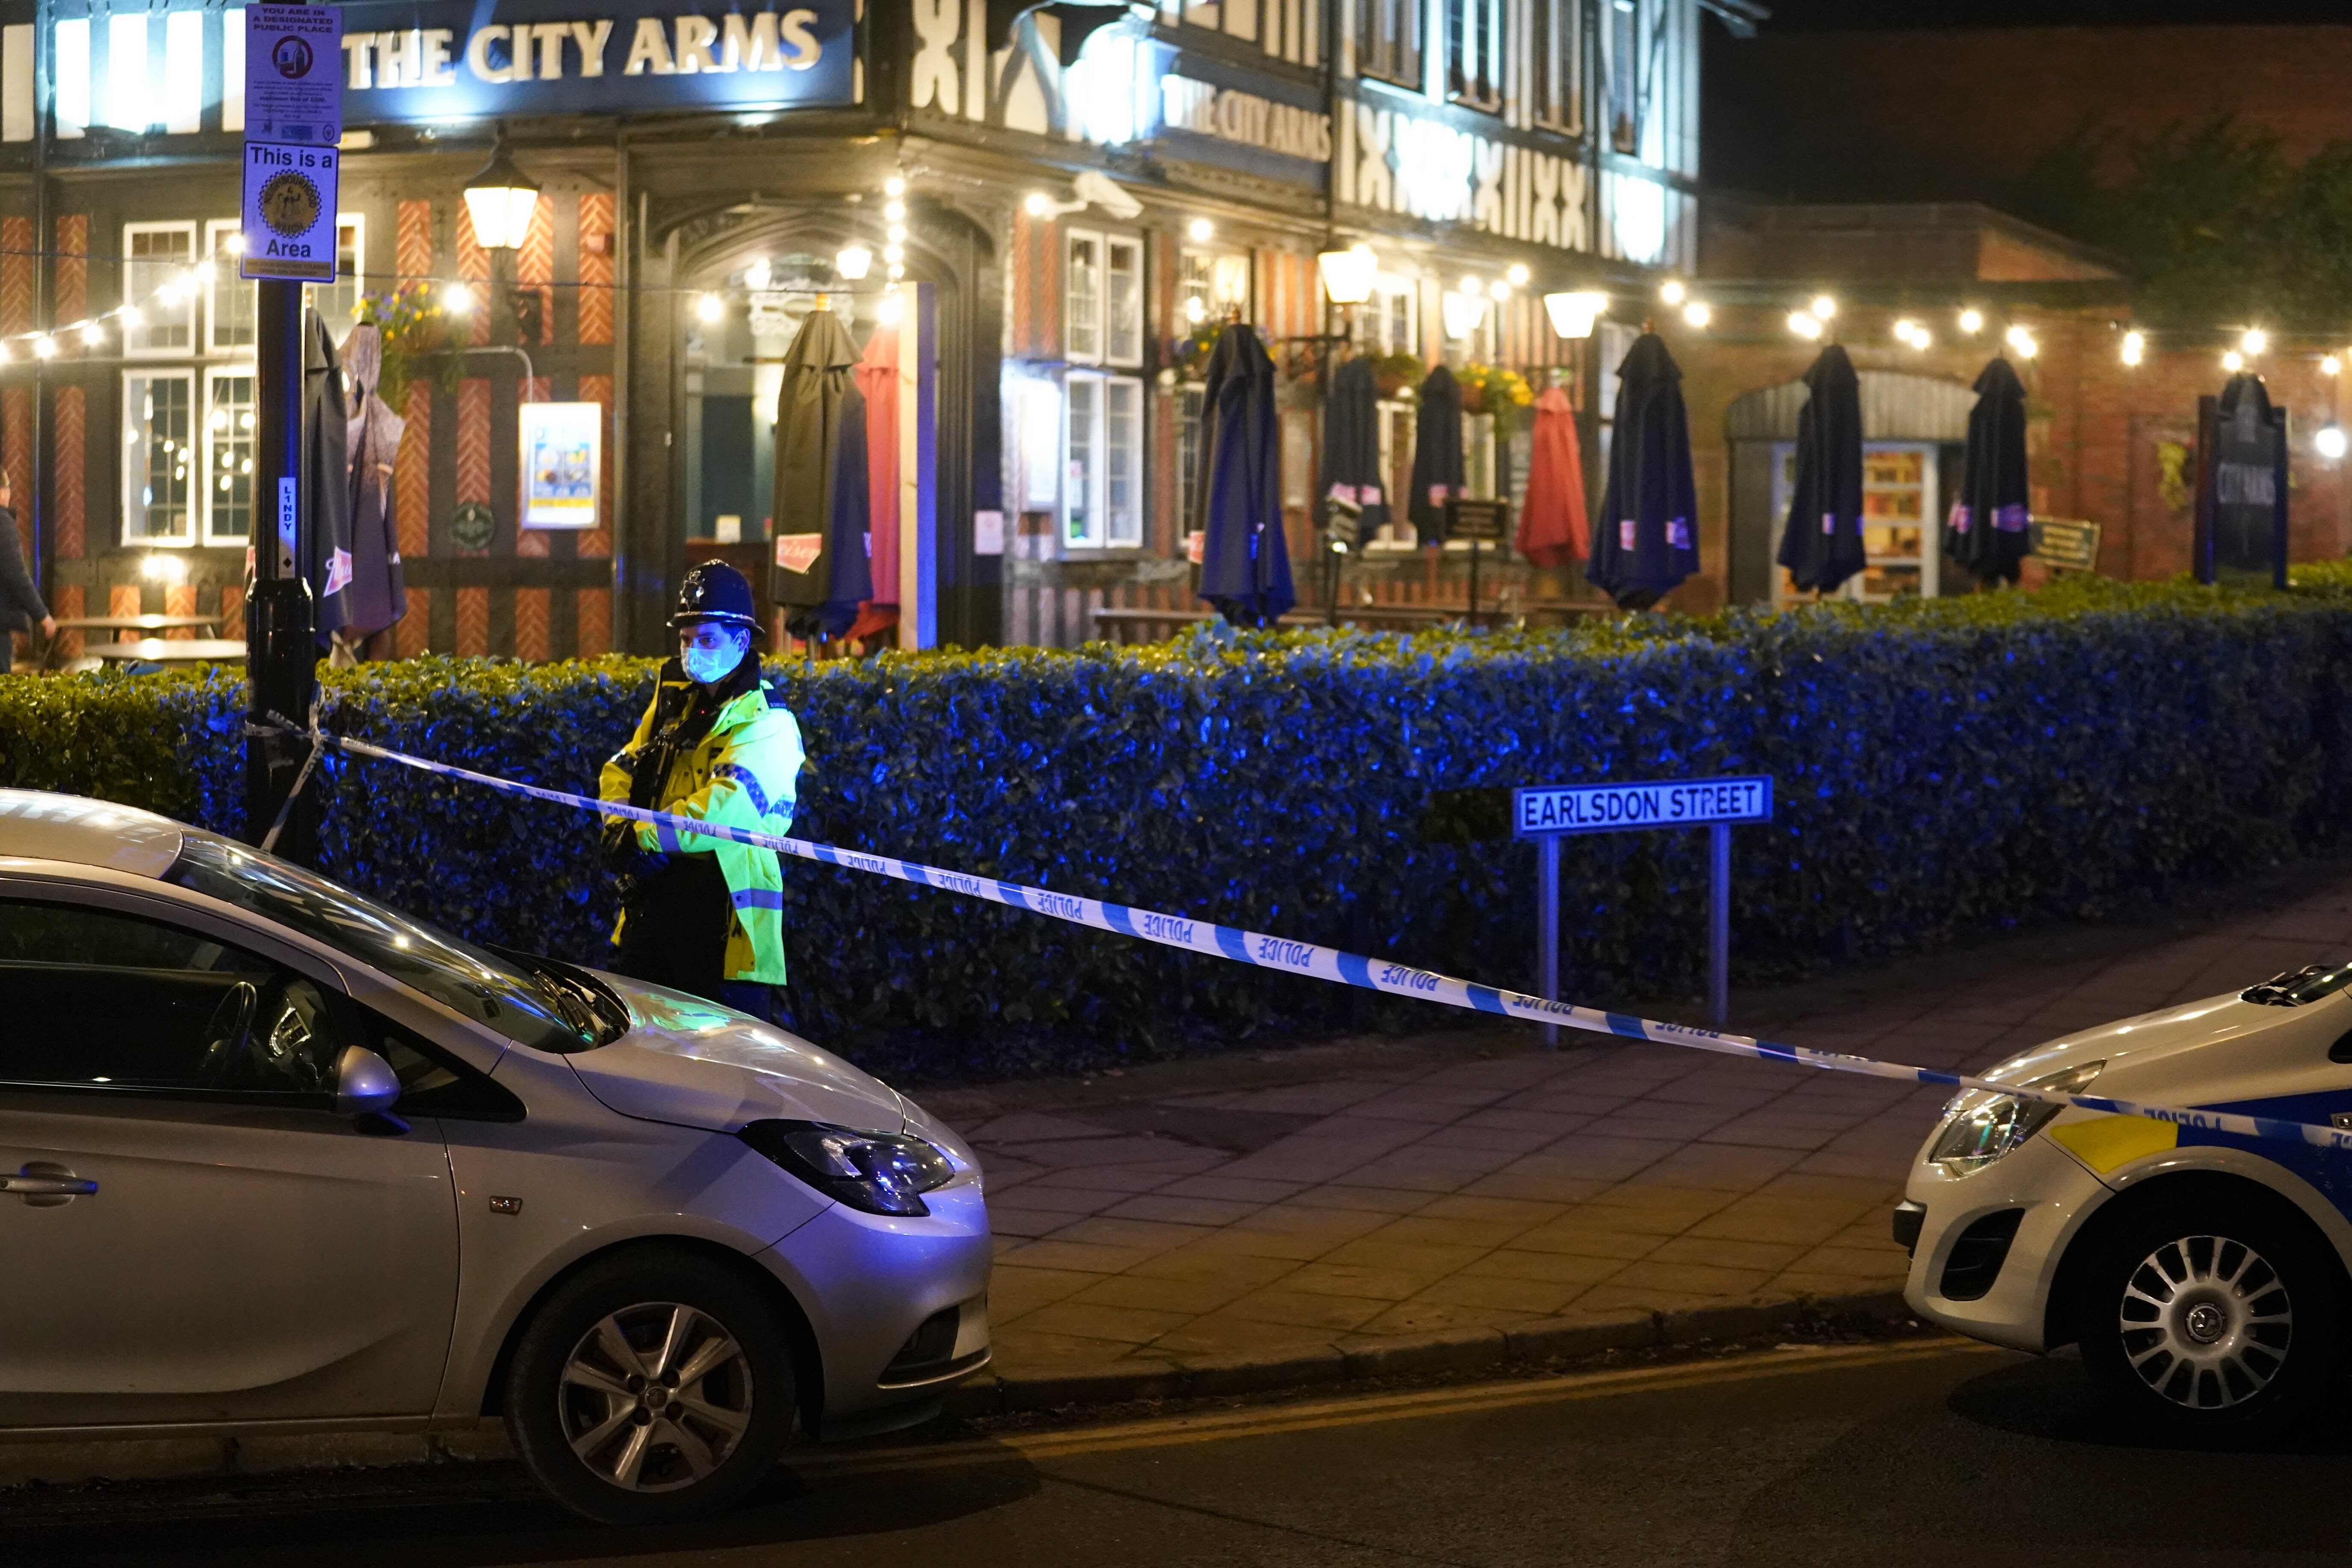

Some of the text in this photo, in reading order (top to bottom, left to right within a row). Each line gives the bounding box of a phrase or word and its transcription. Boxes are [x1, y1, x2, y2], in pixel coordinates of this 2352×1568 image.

[264, 16, 333, 24] DESIGNATED
[341, 9, 823, 89] THE CITY ARMS
[1218, 89, 1271, 146] CITY
[1269, 102, 1331, 163] ARMS
[251, 147, 332, 168] This is a
[266, 239, 311, 258] Area
[1525, 785, 1757, 826] EARLSDON STREET
[847, 855, 887, 876] POLICE
[939, 874, 982, 897] POLICE
[1037, 892, 1084, 920] POLICE
[1143, 914, 1194, 943] POLICE
[1259, 937, 1315, 967] POLICE
[1380, 964, 1441, 992] POLICE
